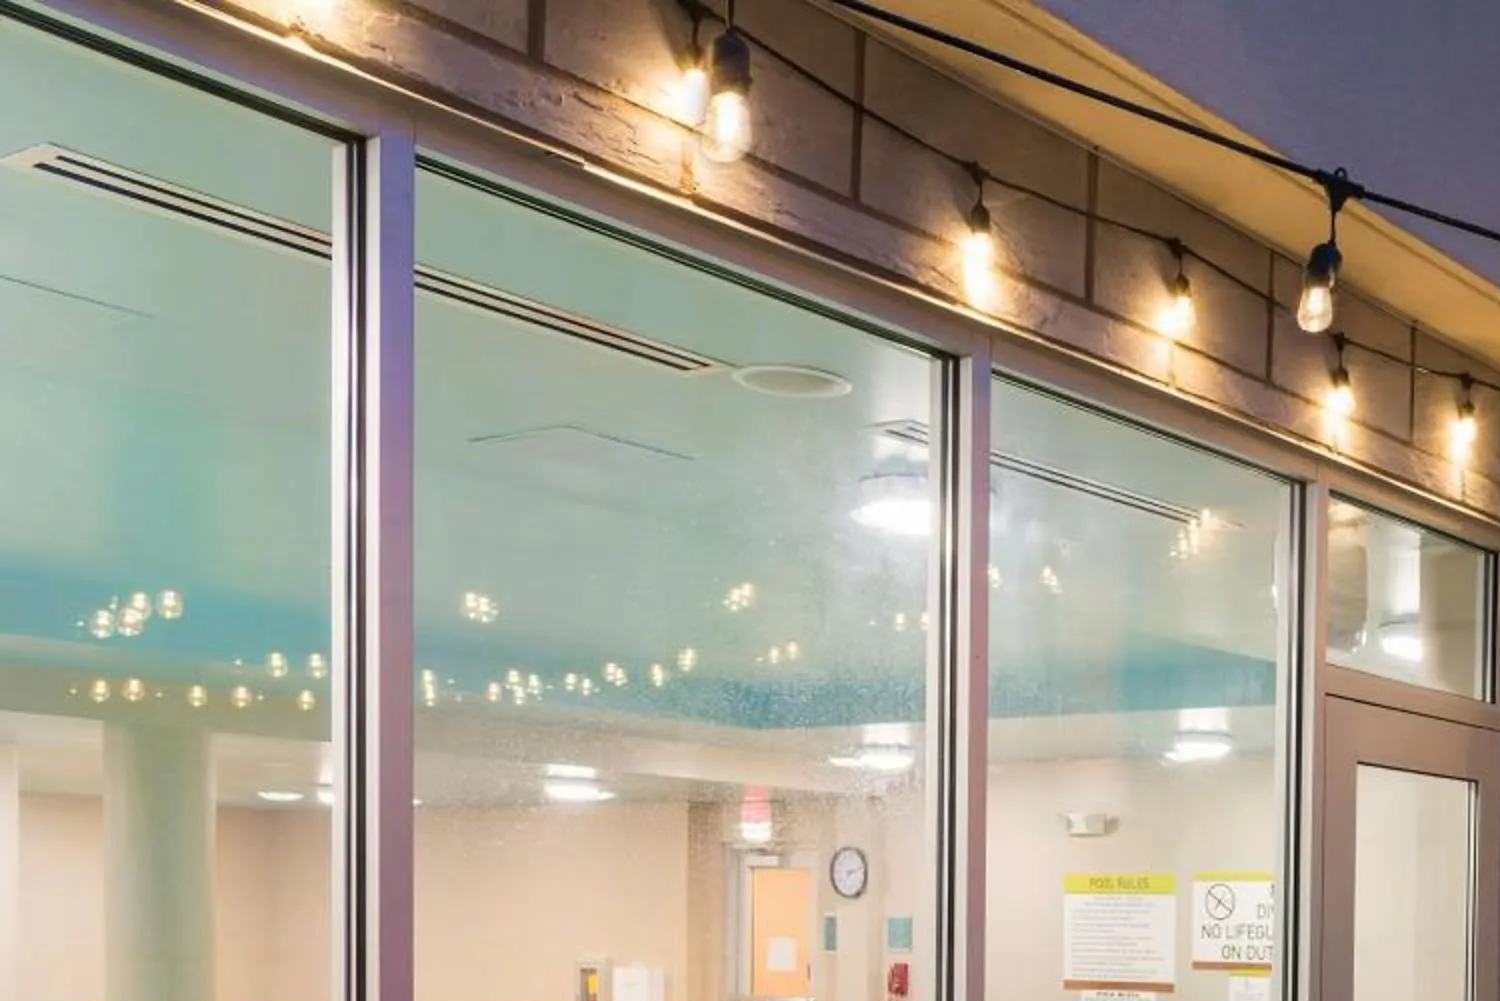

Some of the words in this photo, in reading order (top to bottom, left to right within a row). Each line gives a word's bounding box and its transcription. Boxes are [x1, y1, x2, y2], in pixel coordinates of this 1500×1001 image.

[1117, 876, 1151, 890] RULES
[1201, 923, 1222, 939] NO
[1221, 944, 1242, 960] ON
